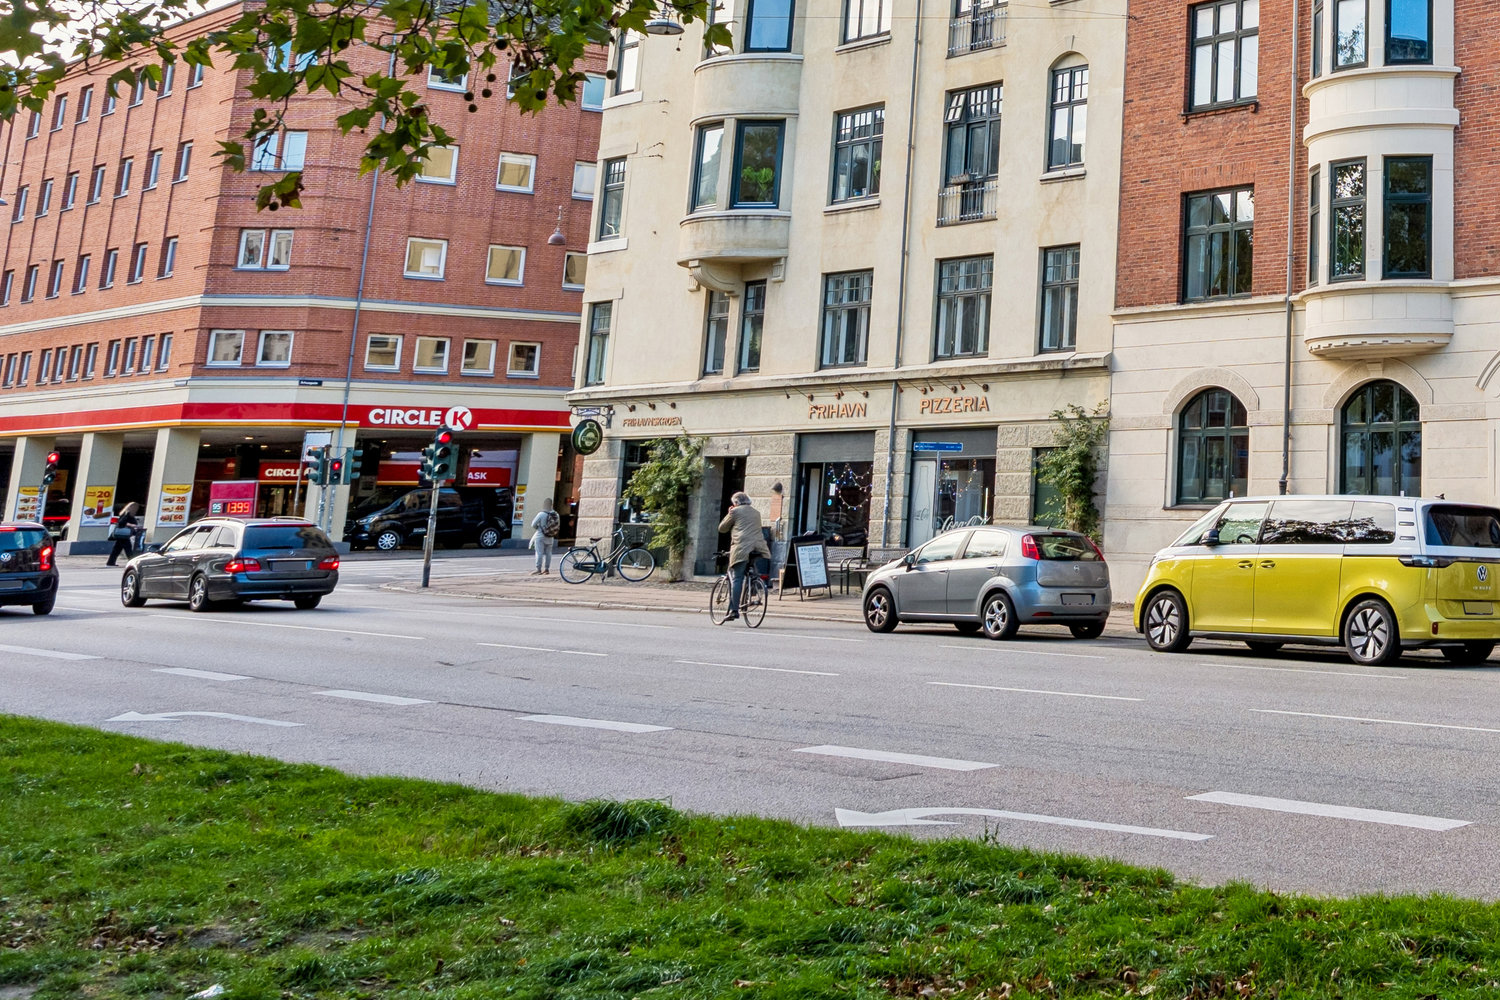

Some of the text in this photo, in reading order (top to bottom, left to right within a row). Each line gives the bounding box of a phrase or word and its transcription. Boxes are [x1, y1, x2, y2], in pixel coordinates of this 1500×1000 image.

[808, 396, 990, 419] FRIHAVN PIZZERIA
[368, 408, 470, 430] CIRCLE K
[467, 471, 488, 480] ASK
